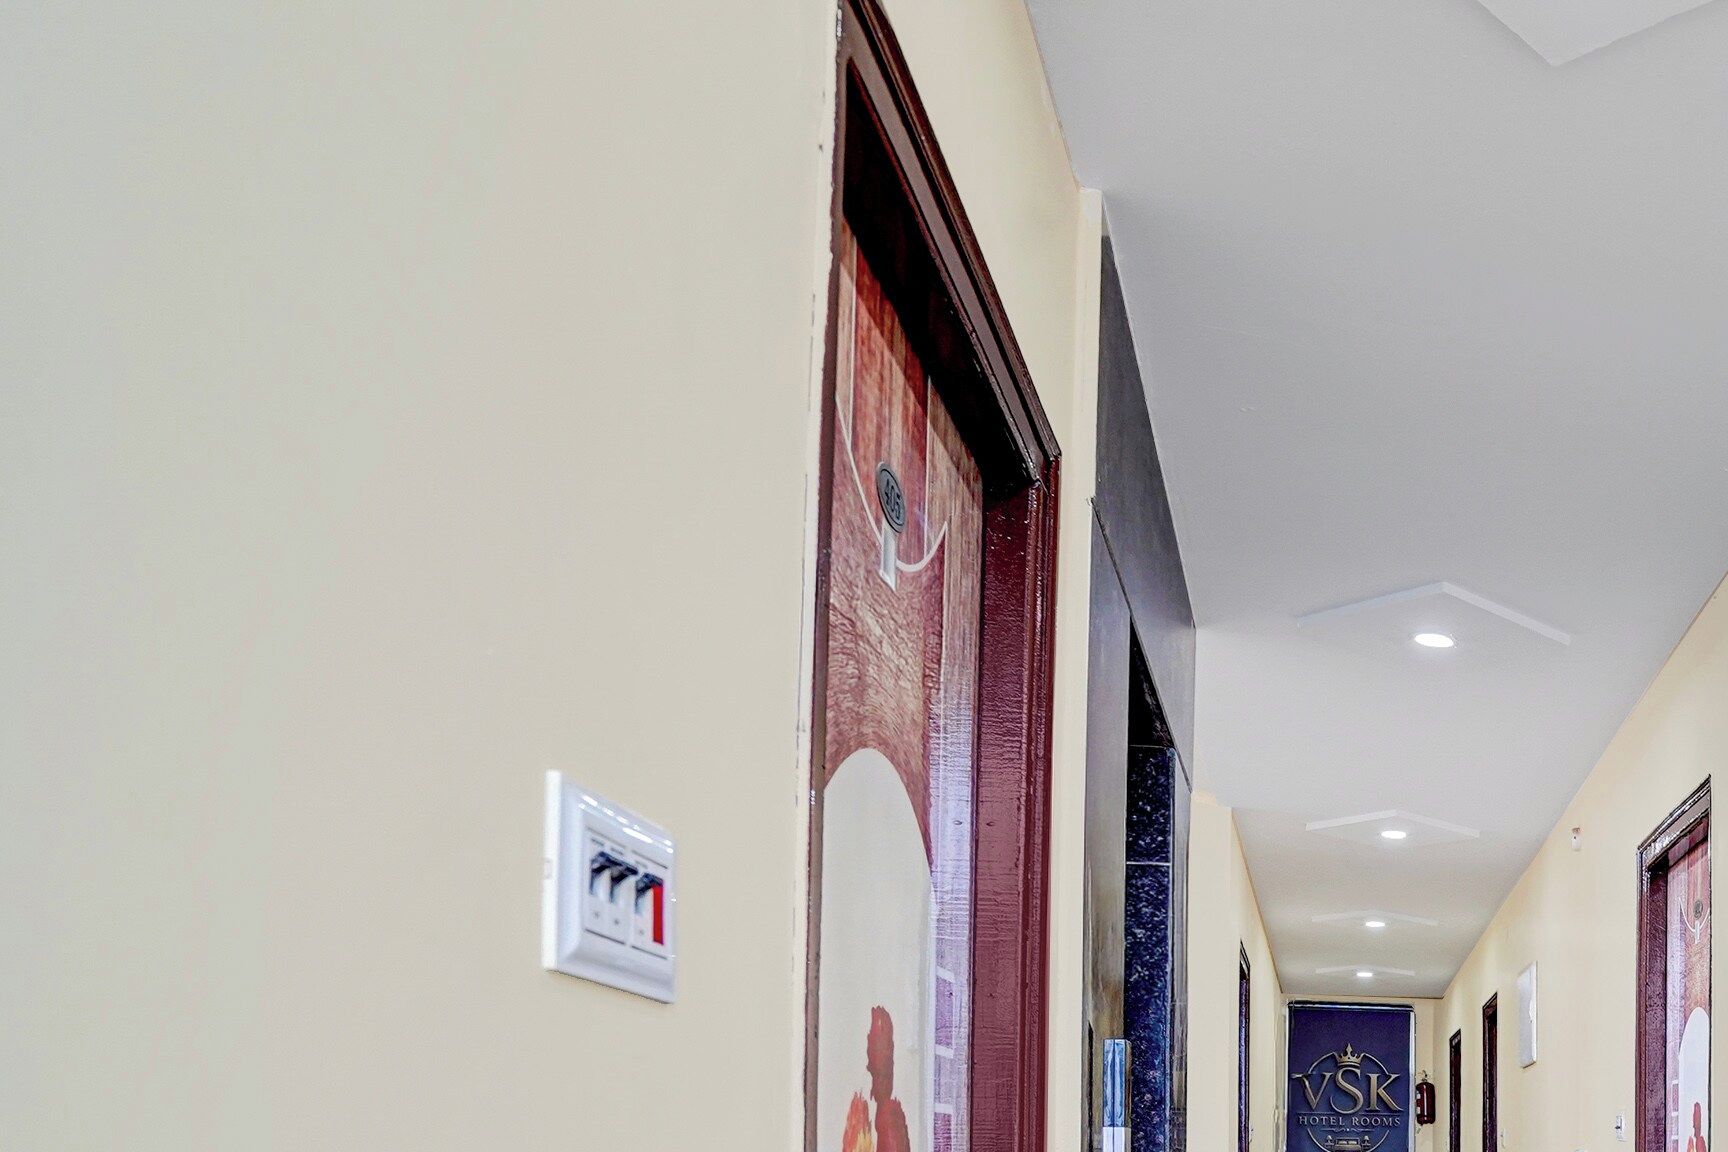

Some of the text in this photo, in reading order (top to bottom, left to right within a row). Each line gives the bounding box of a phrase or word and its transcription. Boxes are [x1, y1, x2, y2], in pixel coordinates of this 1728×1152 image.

[1291, 1067, 1404, 1114] VSK
[1299, 1116, 1400, 1127] HOTEL ROOMS
